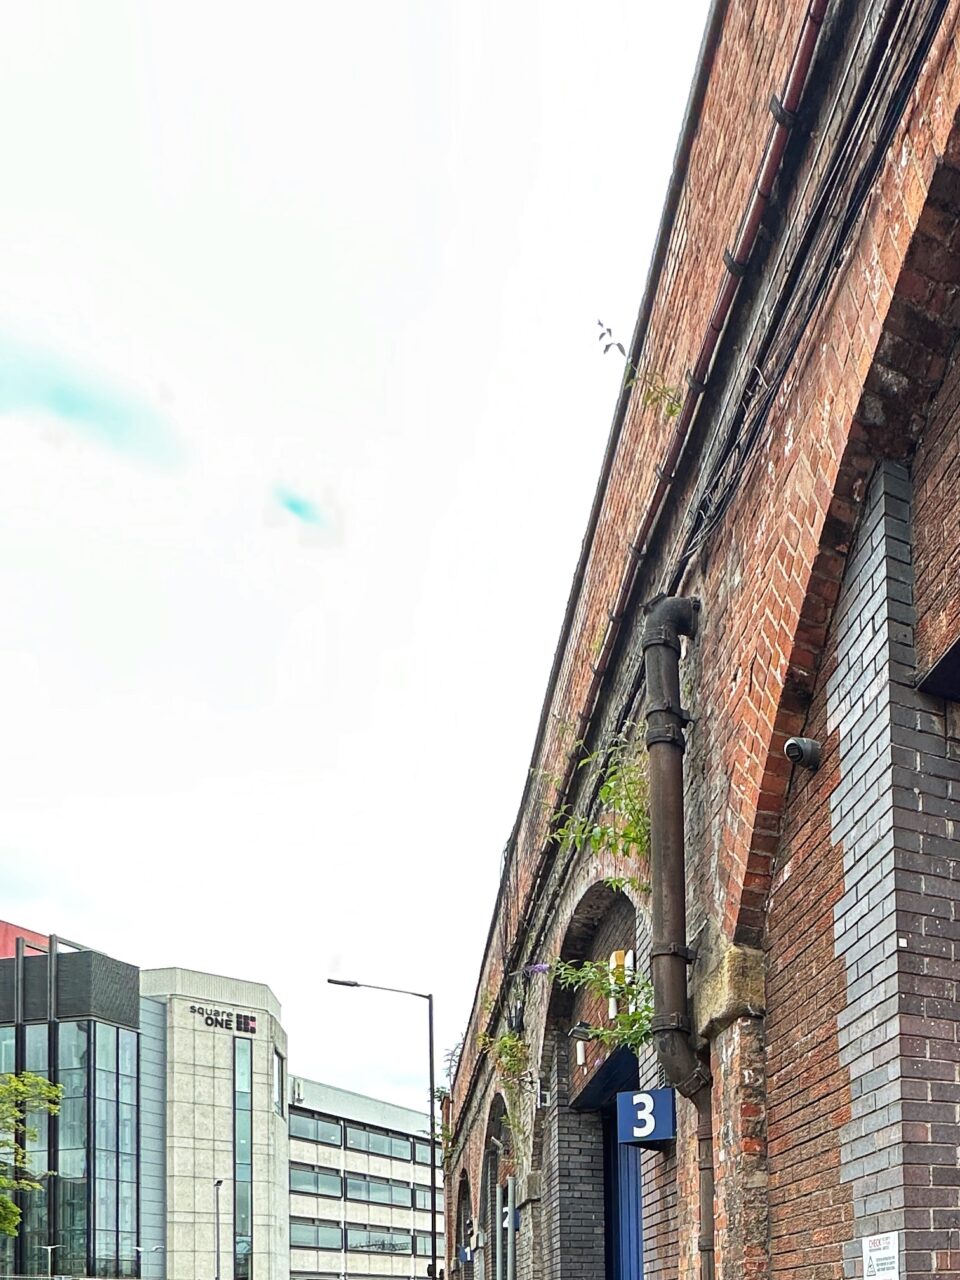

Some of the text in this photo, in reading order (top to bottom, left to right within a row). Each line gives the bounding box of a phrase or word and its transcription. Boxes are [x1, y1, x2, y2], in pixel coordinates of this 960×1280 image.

[189, 1005, 233, 1018] square
[204, 1016, 233, 1030] ONE
[632, 1093, 656, 1138] 3
[464, 1246, 471, 1261] 1
